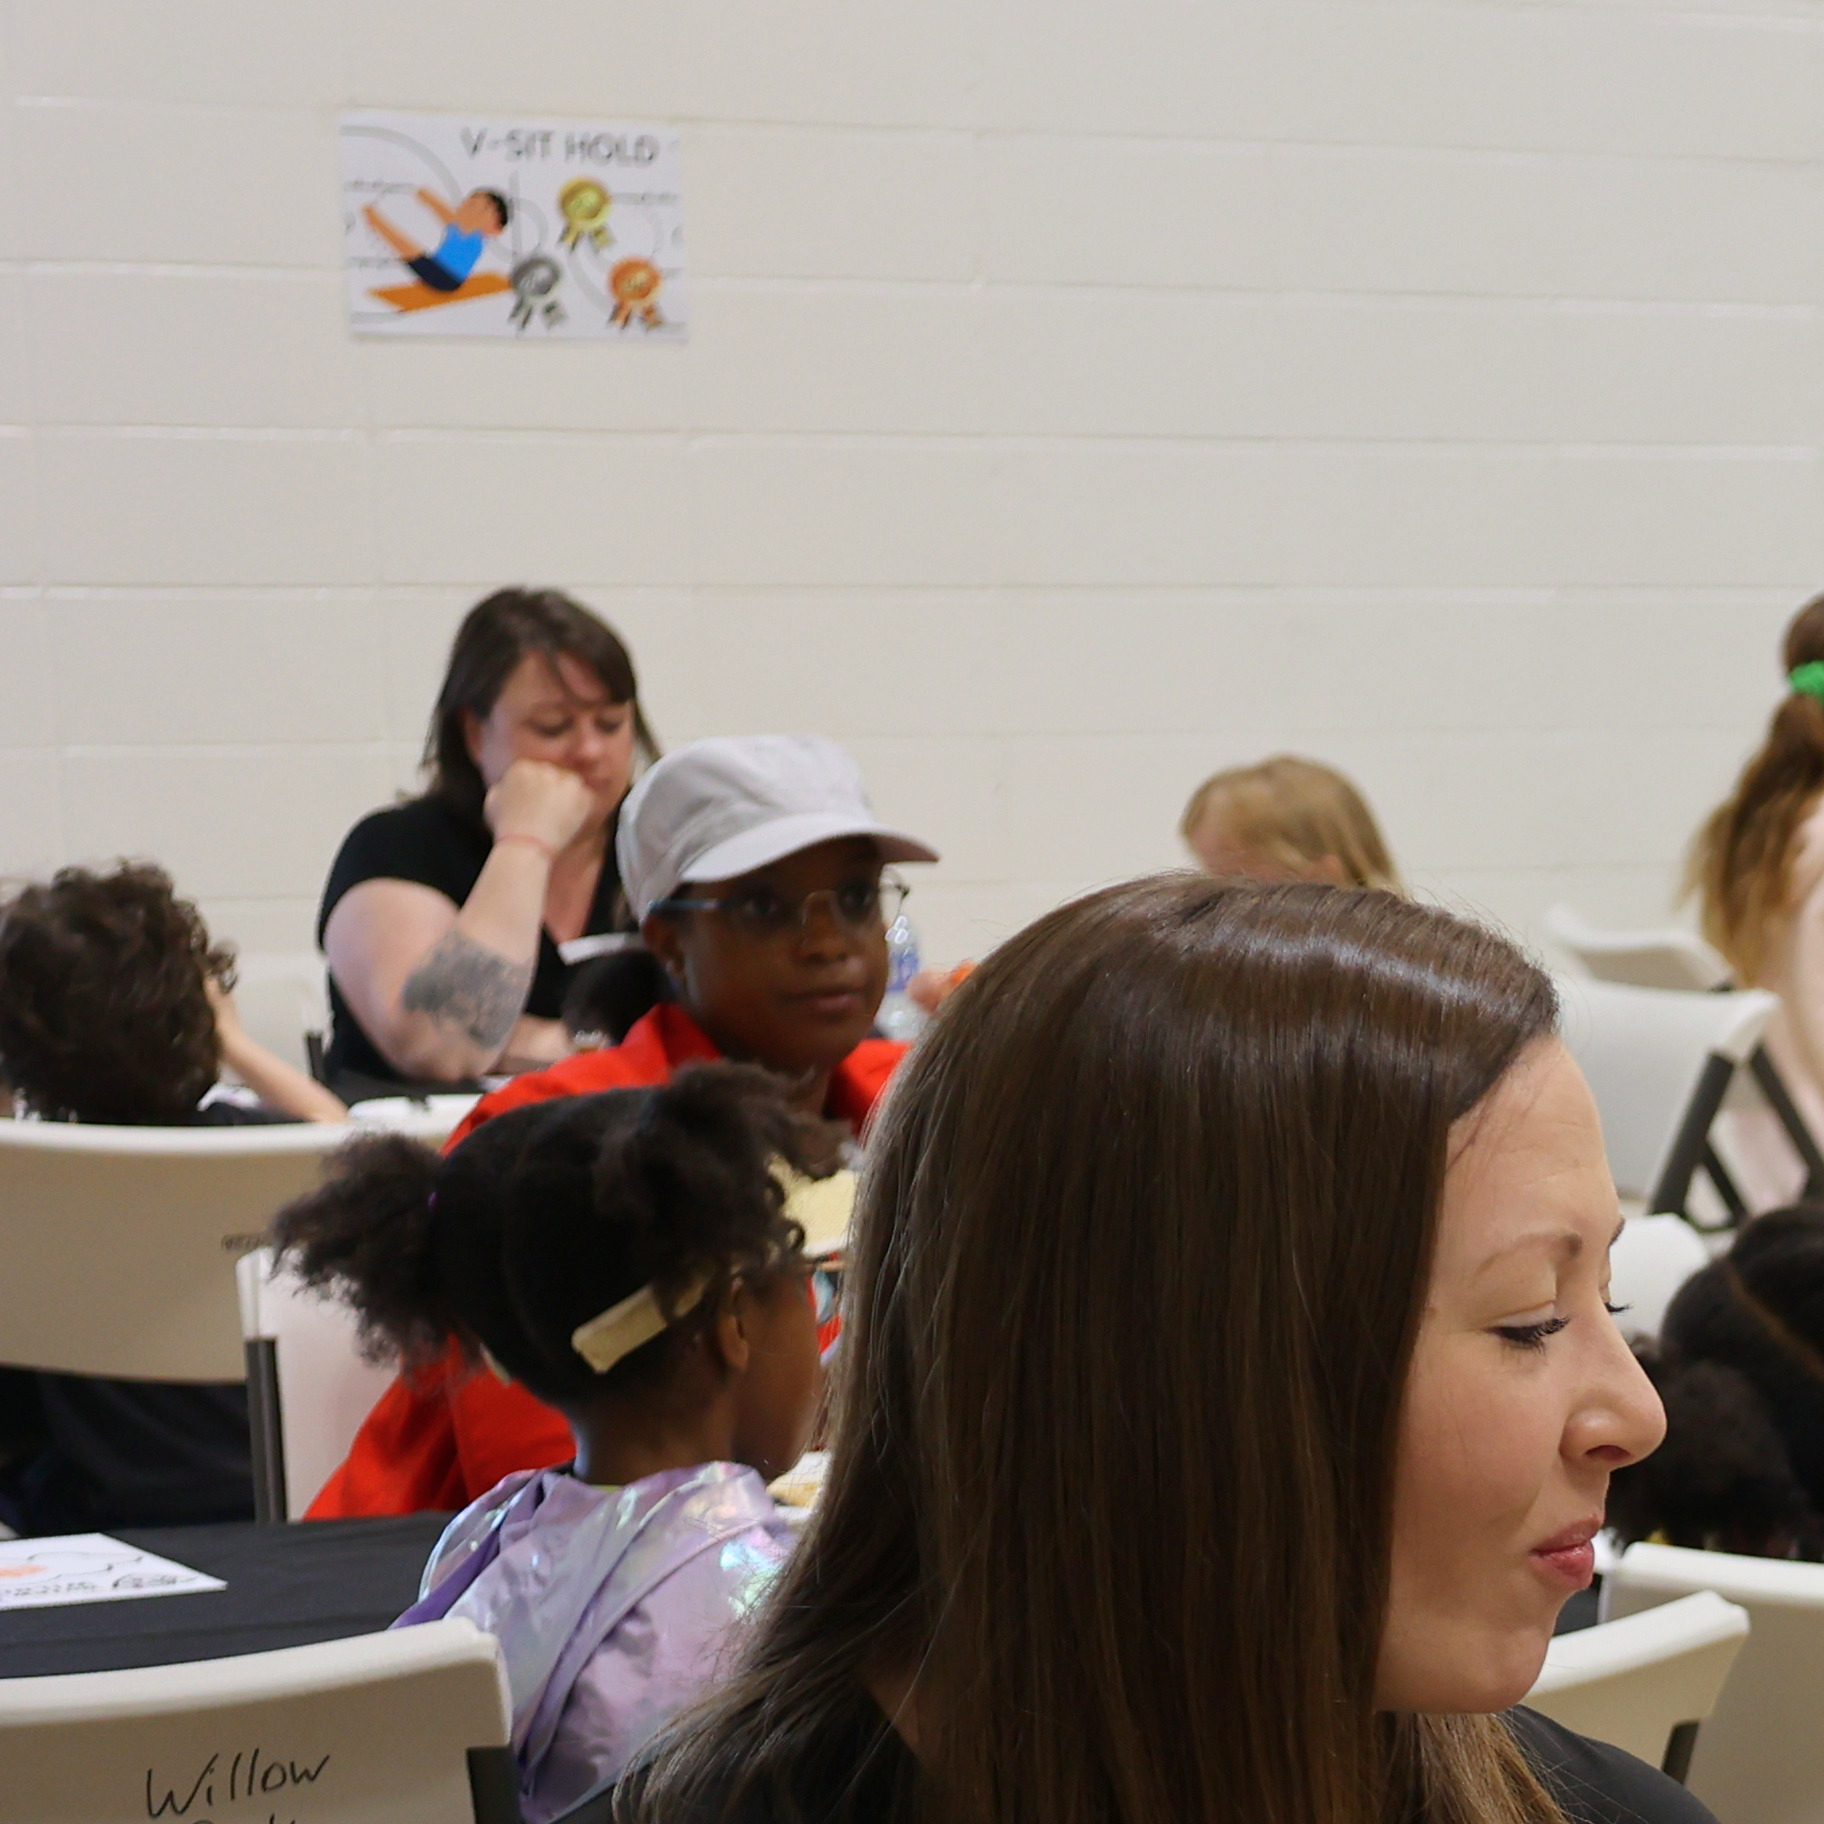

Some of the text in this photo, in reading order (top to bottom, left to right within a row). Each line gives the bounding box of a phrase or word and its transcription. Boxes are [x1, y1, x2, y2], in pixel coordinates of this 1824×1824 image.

[460, 126, 660, 167] V-SIT HOLD
[146, 1748, 330, 1818] Willow
